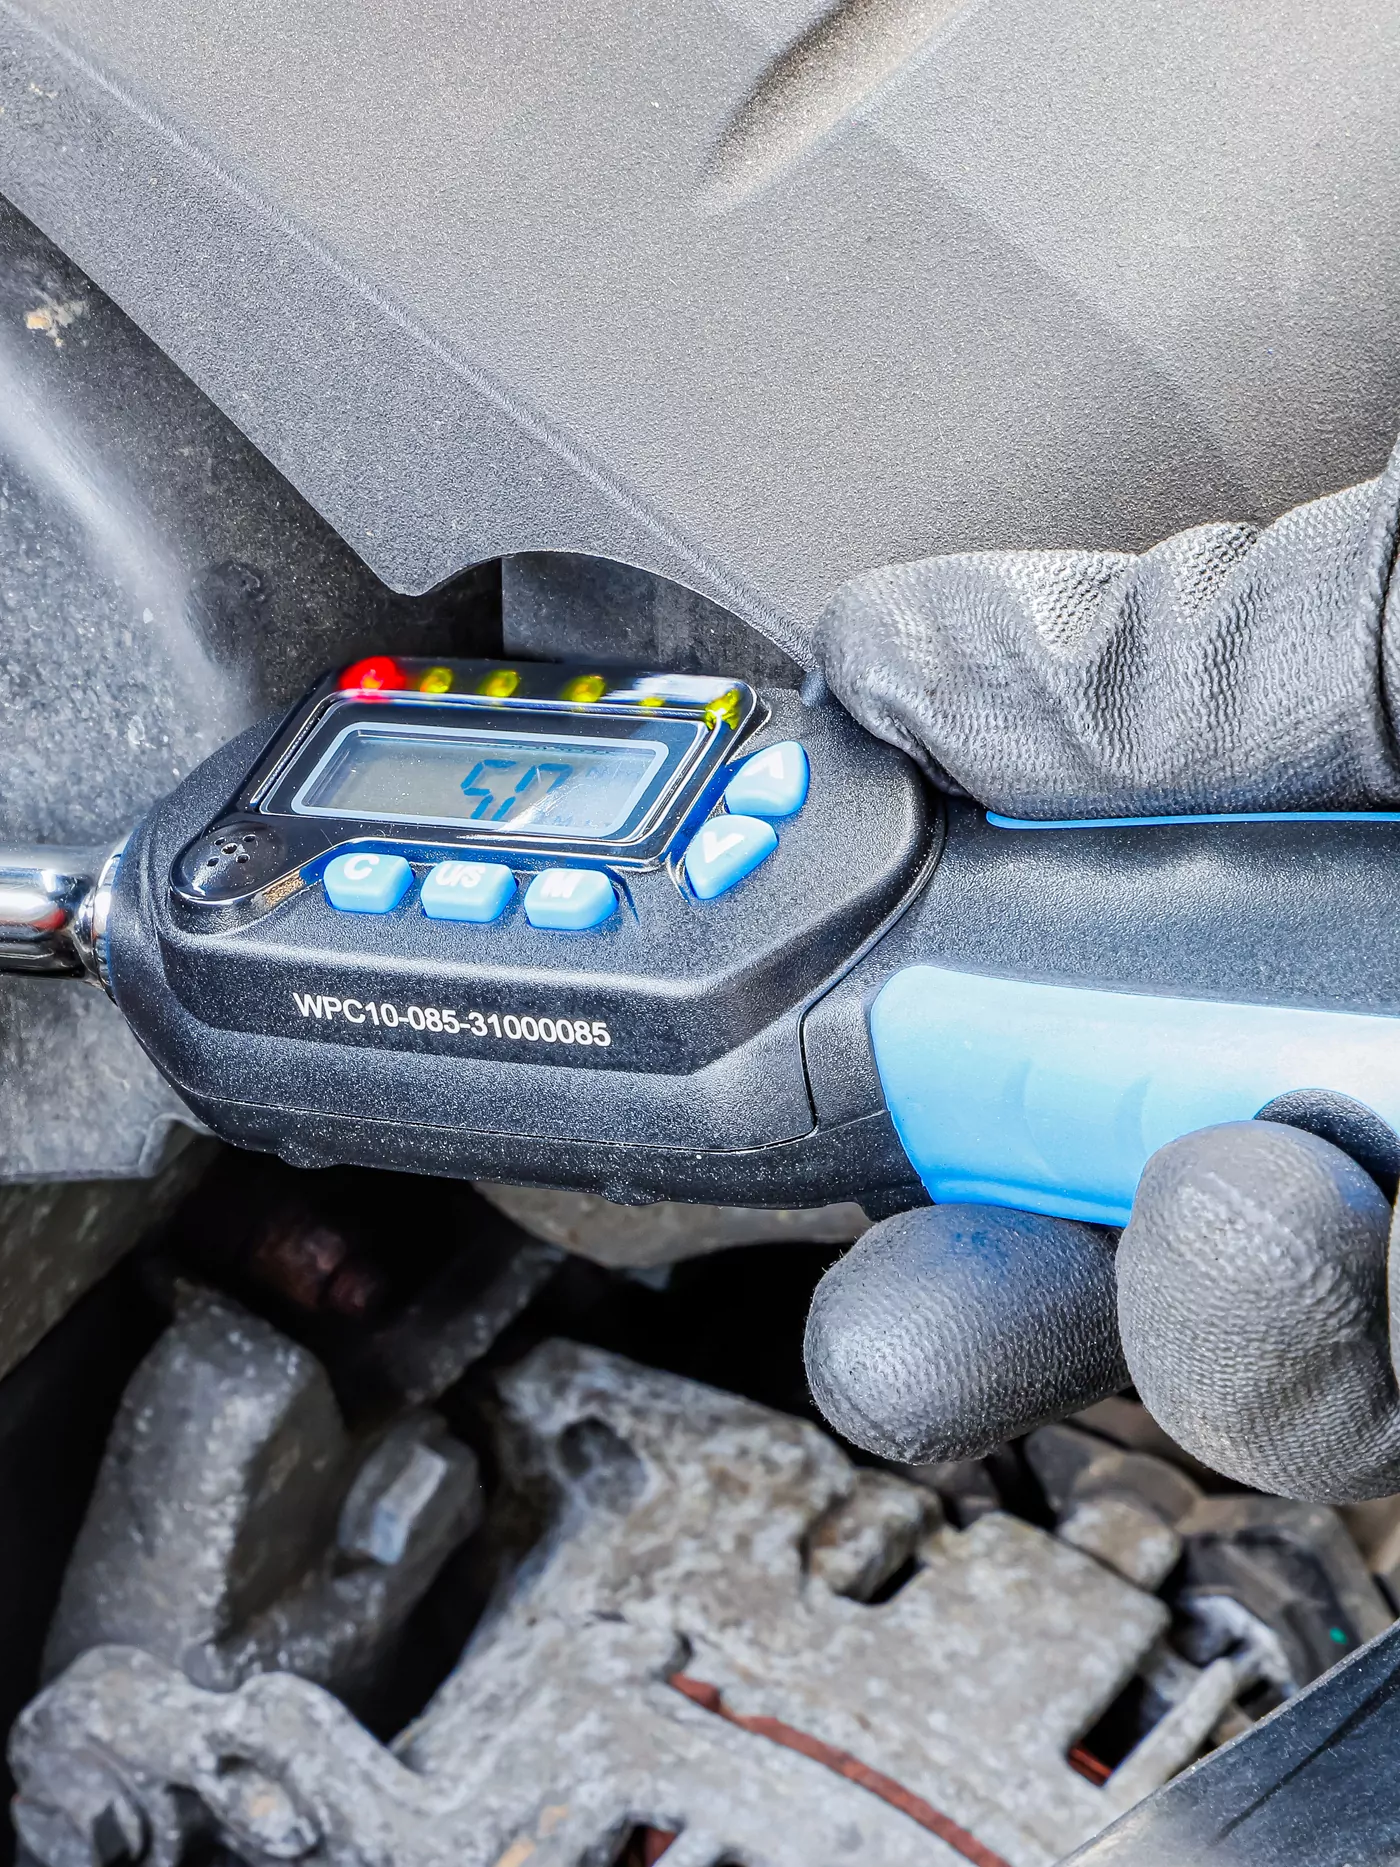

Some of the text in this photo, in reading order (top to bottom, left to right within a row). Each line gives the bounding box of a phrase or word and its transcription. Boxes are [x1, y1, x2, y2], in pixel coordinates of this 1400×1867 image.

[343, 854, 380, 881] C
[540, 871, 584, 899] M
[292, 992, 612, 1047] WPC10-085-31000085
